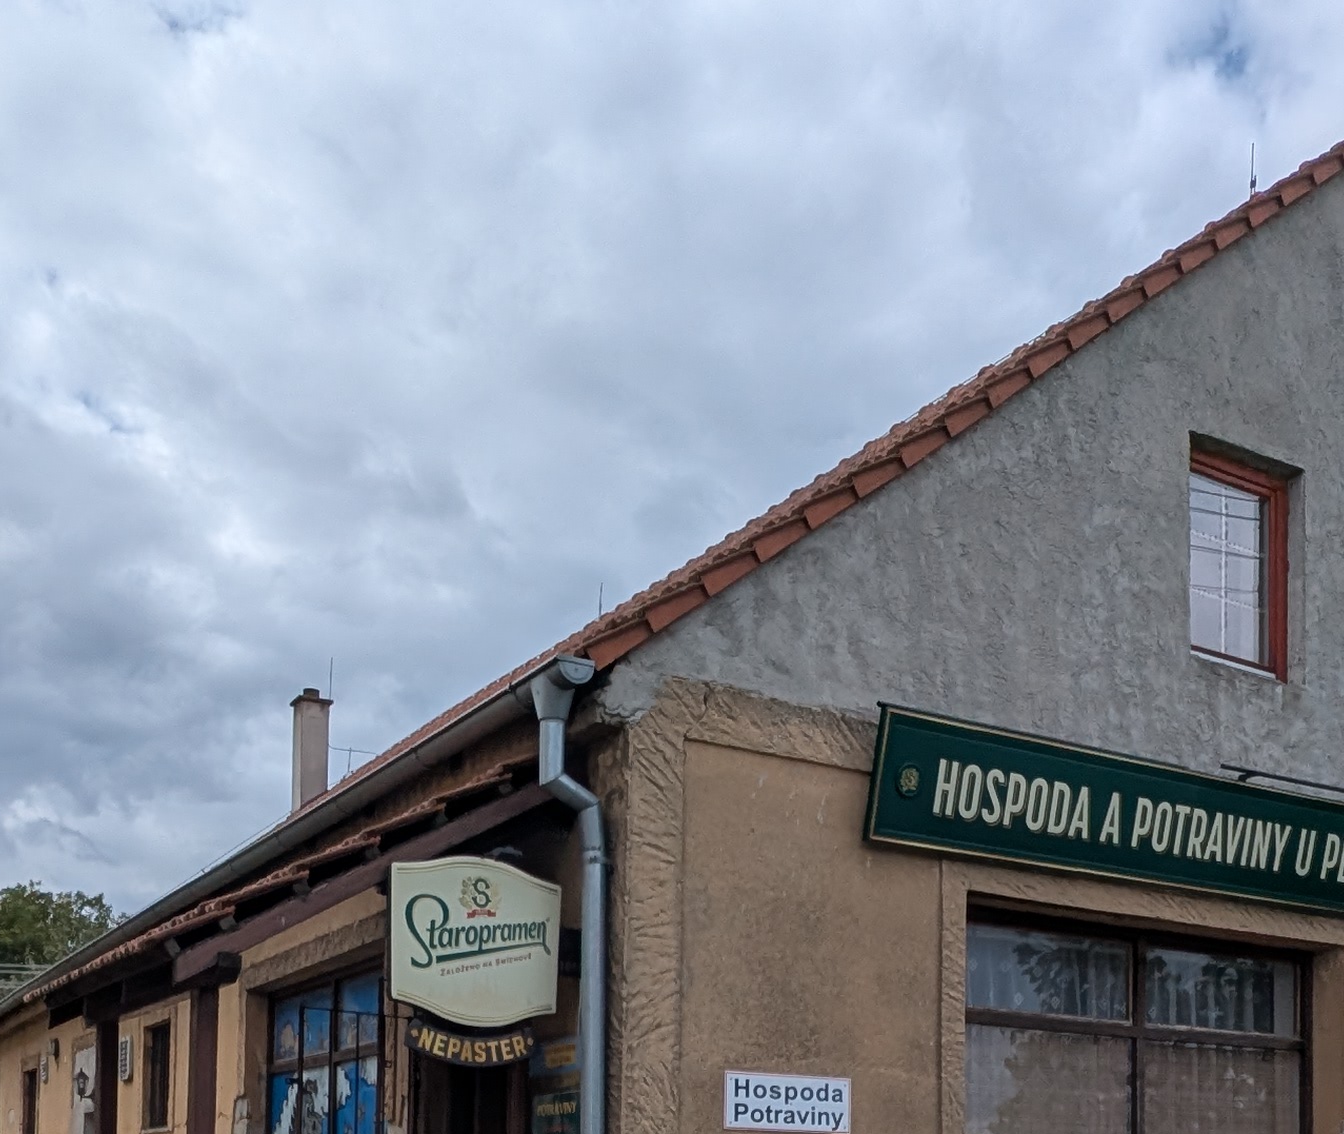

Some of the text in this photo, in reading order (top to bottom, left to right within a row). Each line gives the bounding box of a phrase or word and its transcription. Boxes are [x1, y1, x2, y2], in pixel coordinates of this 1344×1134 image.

[932, 757, 1090, 840] HOSPODA
[1098, 792, 1121, 845] A
[1130, 797, 1293, 873] POTRAVINY
[1294, 828, 1317, 877] U
[405, 893, 552, 969] Staropramen
[418, 1027, 527, 1063] NEPASTER
[734, 1078, 843, 1105] Hospoda
[734, 1103, 844, 1131] Potraviny
